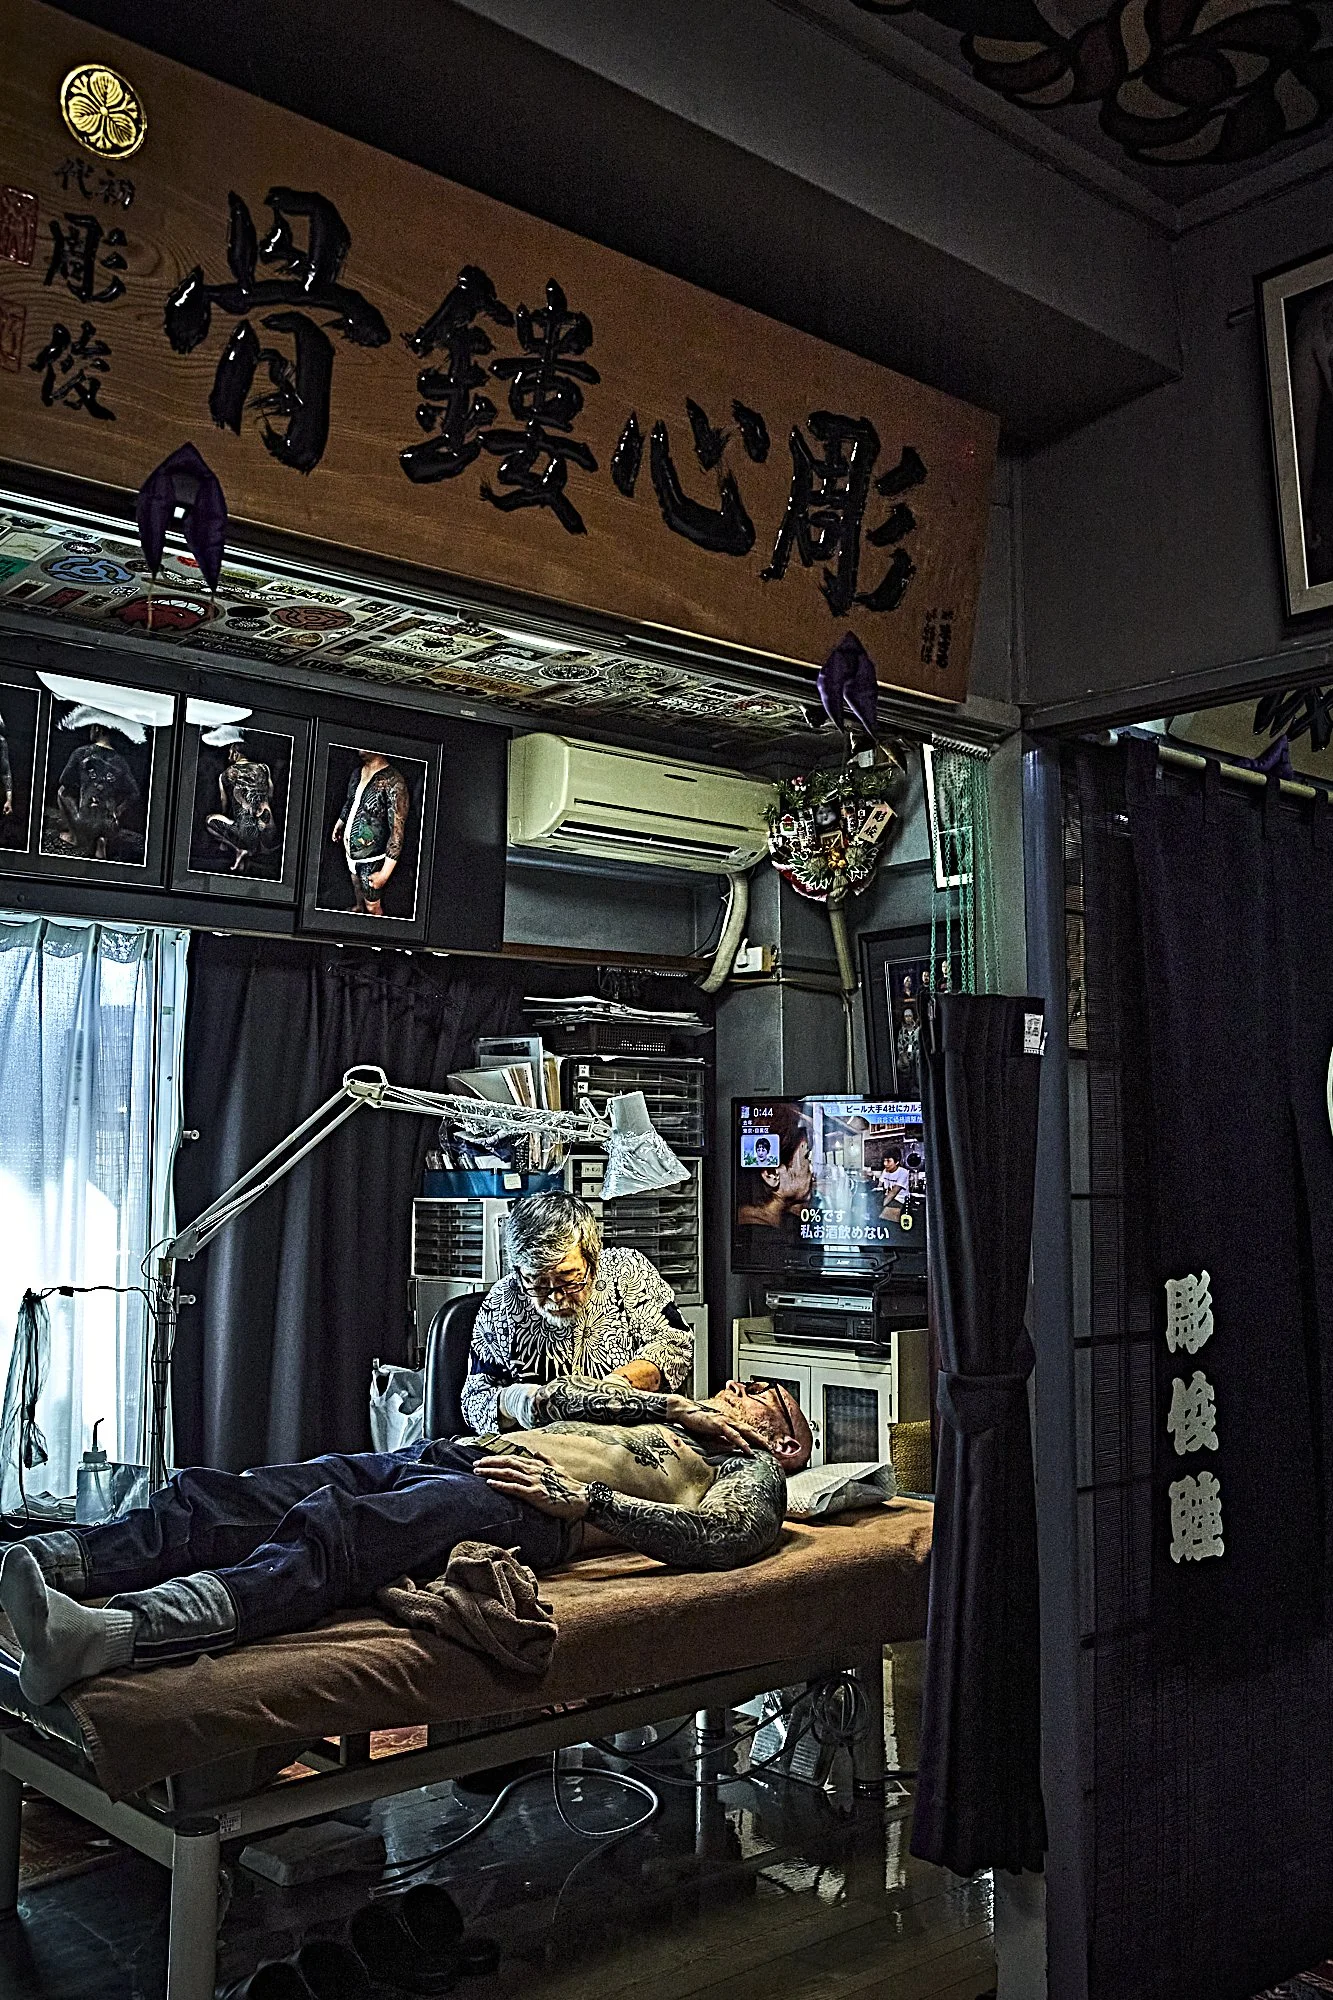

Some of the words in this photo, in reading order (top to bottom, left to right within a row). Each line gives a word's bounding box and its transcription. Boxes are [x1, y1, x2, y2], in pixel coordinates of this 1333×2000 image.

[753, 1107, 773, 1118] 0:44
[800, 1208, 845, 1222] 0%です
[800, 1224, 890, 1240] 私お酒飲めない
